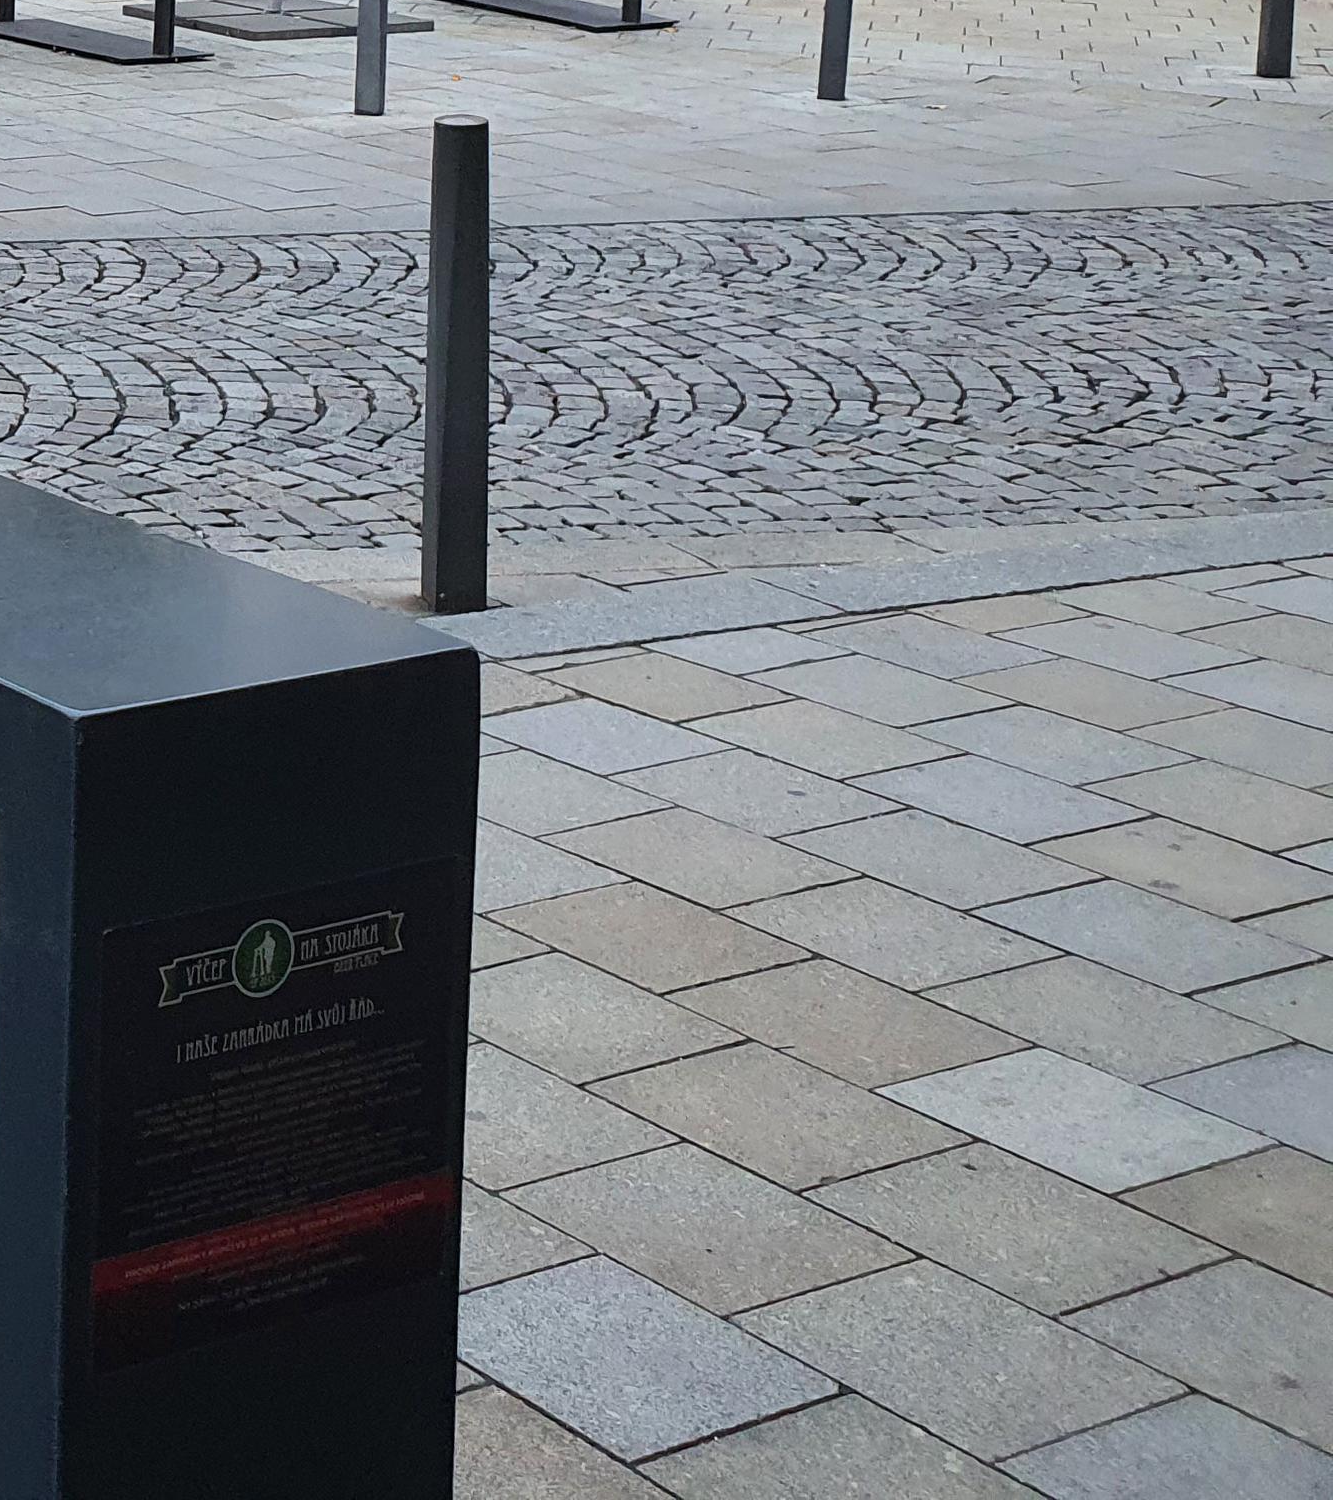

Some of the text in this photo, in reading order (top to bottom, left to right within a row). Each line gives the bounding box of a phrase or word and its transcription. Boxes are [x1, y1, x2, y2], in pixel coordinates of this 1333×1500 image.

[300, 923, 379, 961] NA STOJÁKA
[185, 956, 226, 987] VÝČEP
[185, 1034, 219, 1062] NAŠE
[293, 1008, 313, 1036] MÁ
